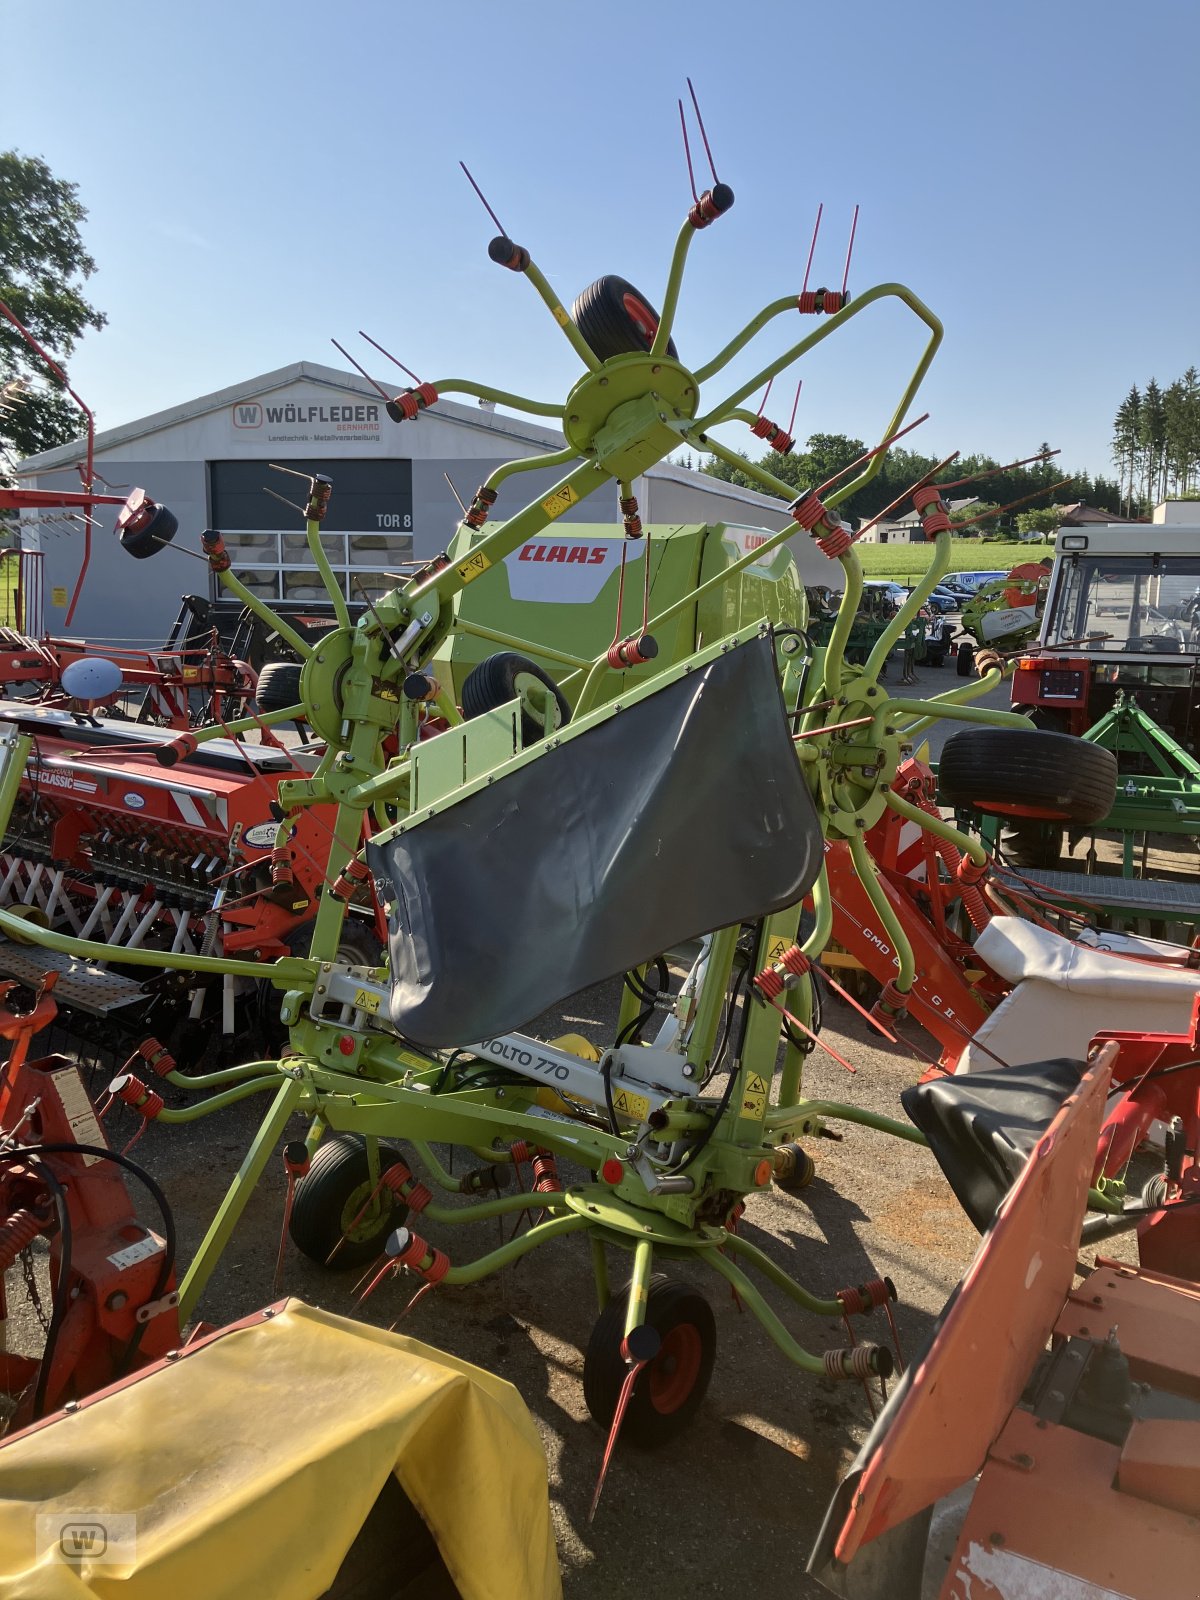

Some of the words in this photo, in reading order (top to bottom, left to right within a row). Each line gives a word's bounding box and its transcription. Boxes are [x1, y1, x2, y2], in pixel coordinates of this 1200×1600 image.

[239, 407, 257, 424] W
[266, 403, 379, 423] WÖLFLEDER
[336, 423, 380, 431] BERNHARD
[376, 514, 400, 528] TOR
[403, 514, 412, 528] 8
[518, 544, 608, 564] CLAAS
[41, 771, 74, 789] CLASSIC
[862, 928, 890, 955] GMD
[931, 995, 942, 1006] G
[480, 1040, 533, 1066] VOLTO
[534, 1056, 570, 1080] 770
